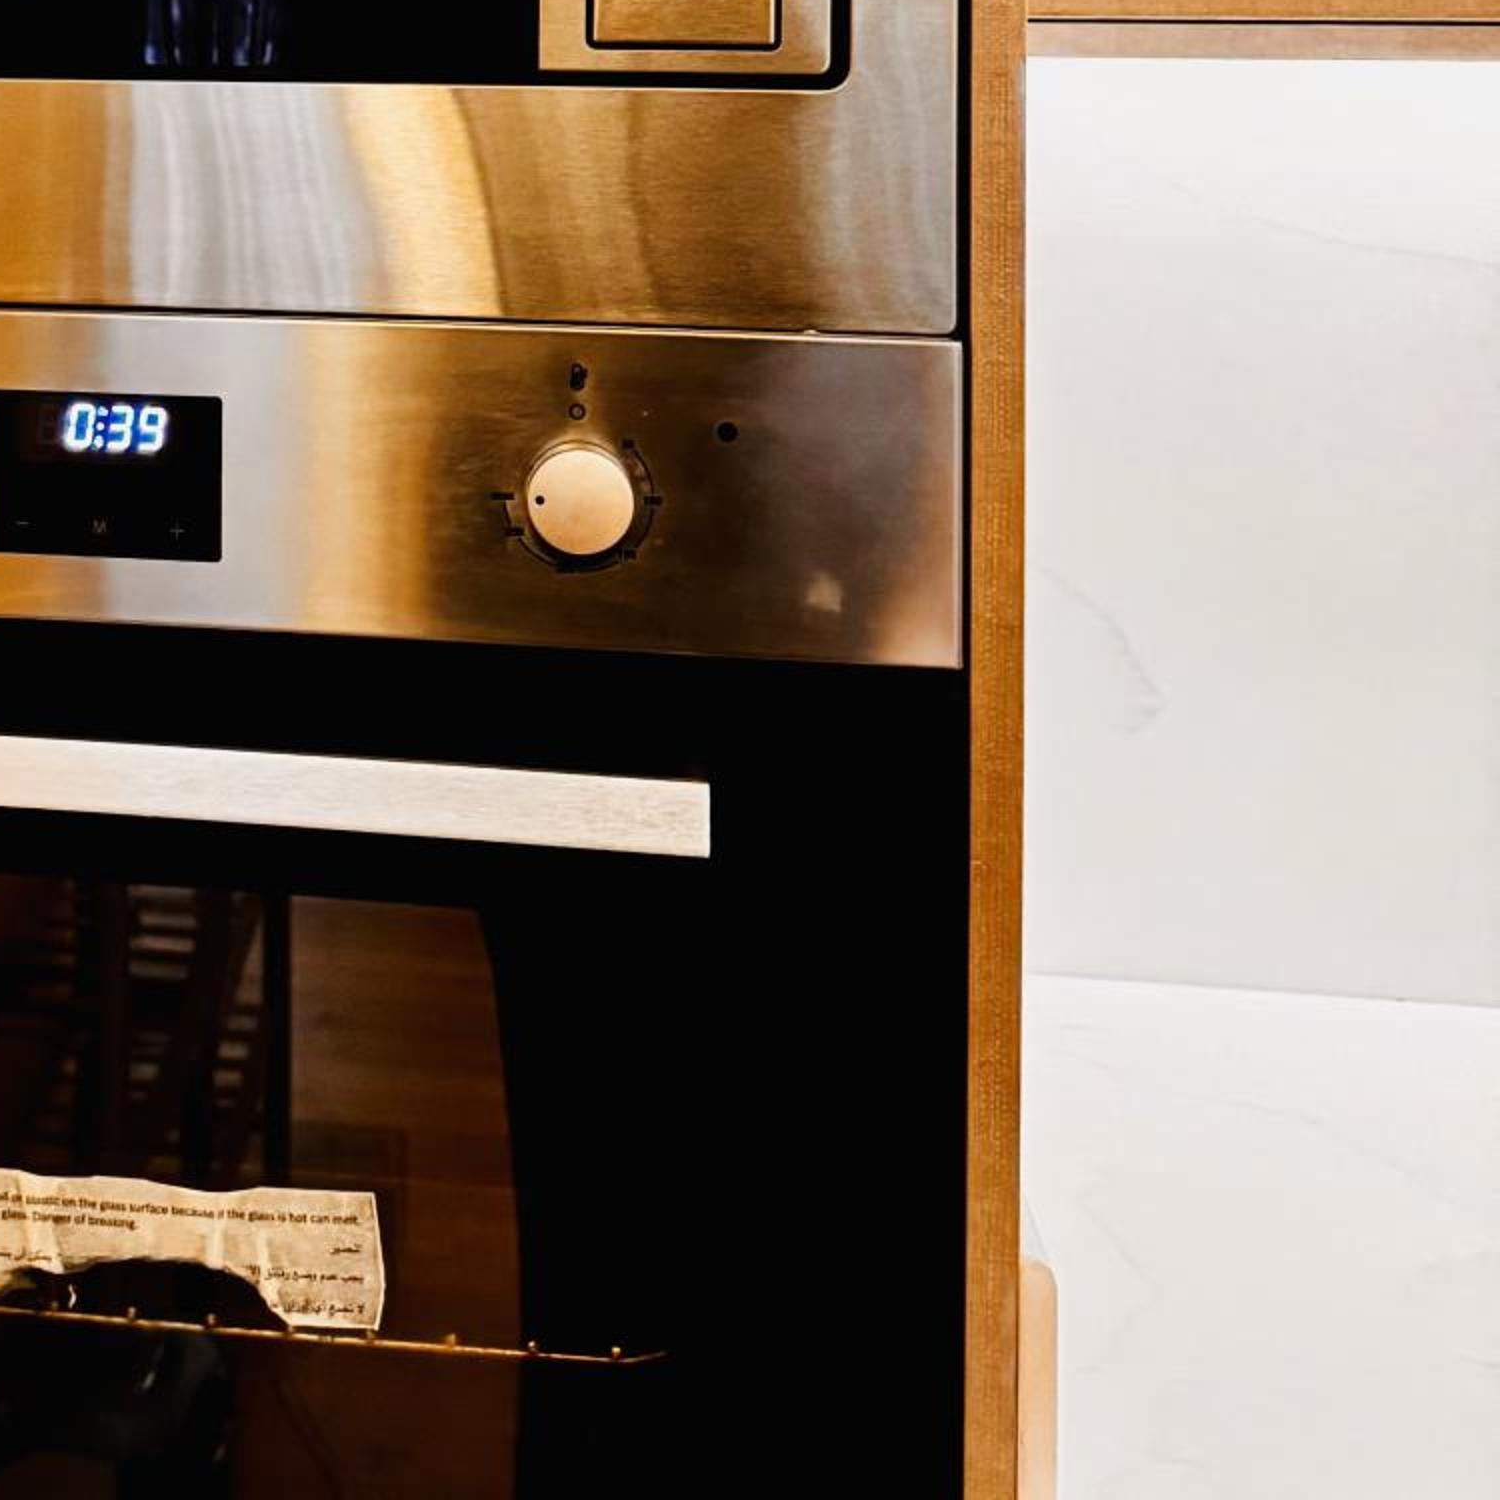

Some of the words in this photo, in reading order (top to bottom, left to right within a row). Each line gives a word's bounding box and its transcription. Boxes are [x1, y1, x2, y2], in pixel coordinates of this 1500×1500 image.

[63, 401, 169, 455] 0:39
[62, 1198, 77, 1207] on
[79, 1197, 97, 1208] the
[100, 1200, 127, 1212] glass
[129, 1202, 169, 1214] surface
[227, 1209, 246, 1219] the
[289, 1213, 308, 1223] hot
[310, 1214, 330, 1224] can
[74, 1213, 85, 1225] of
